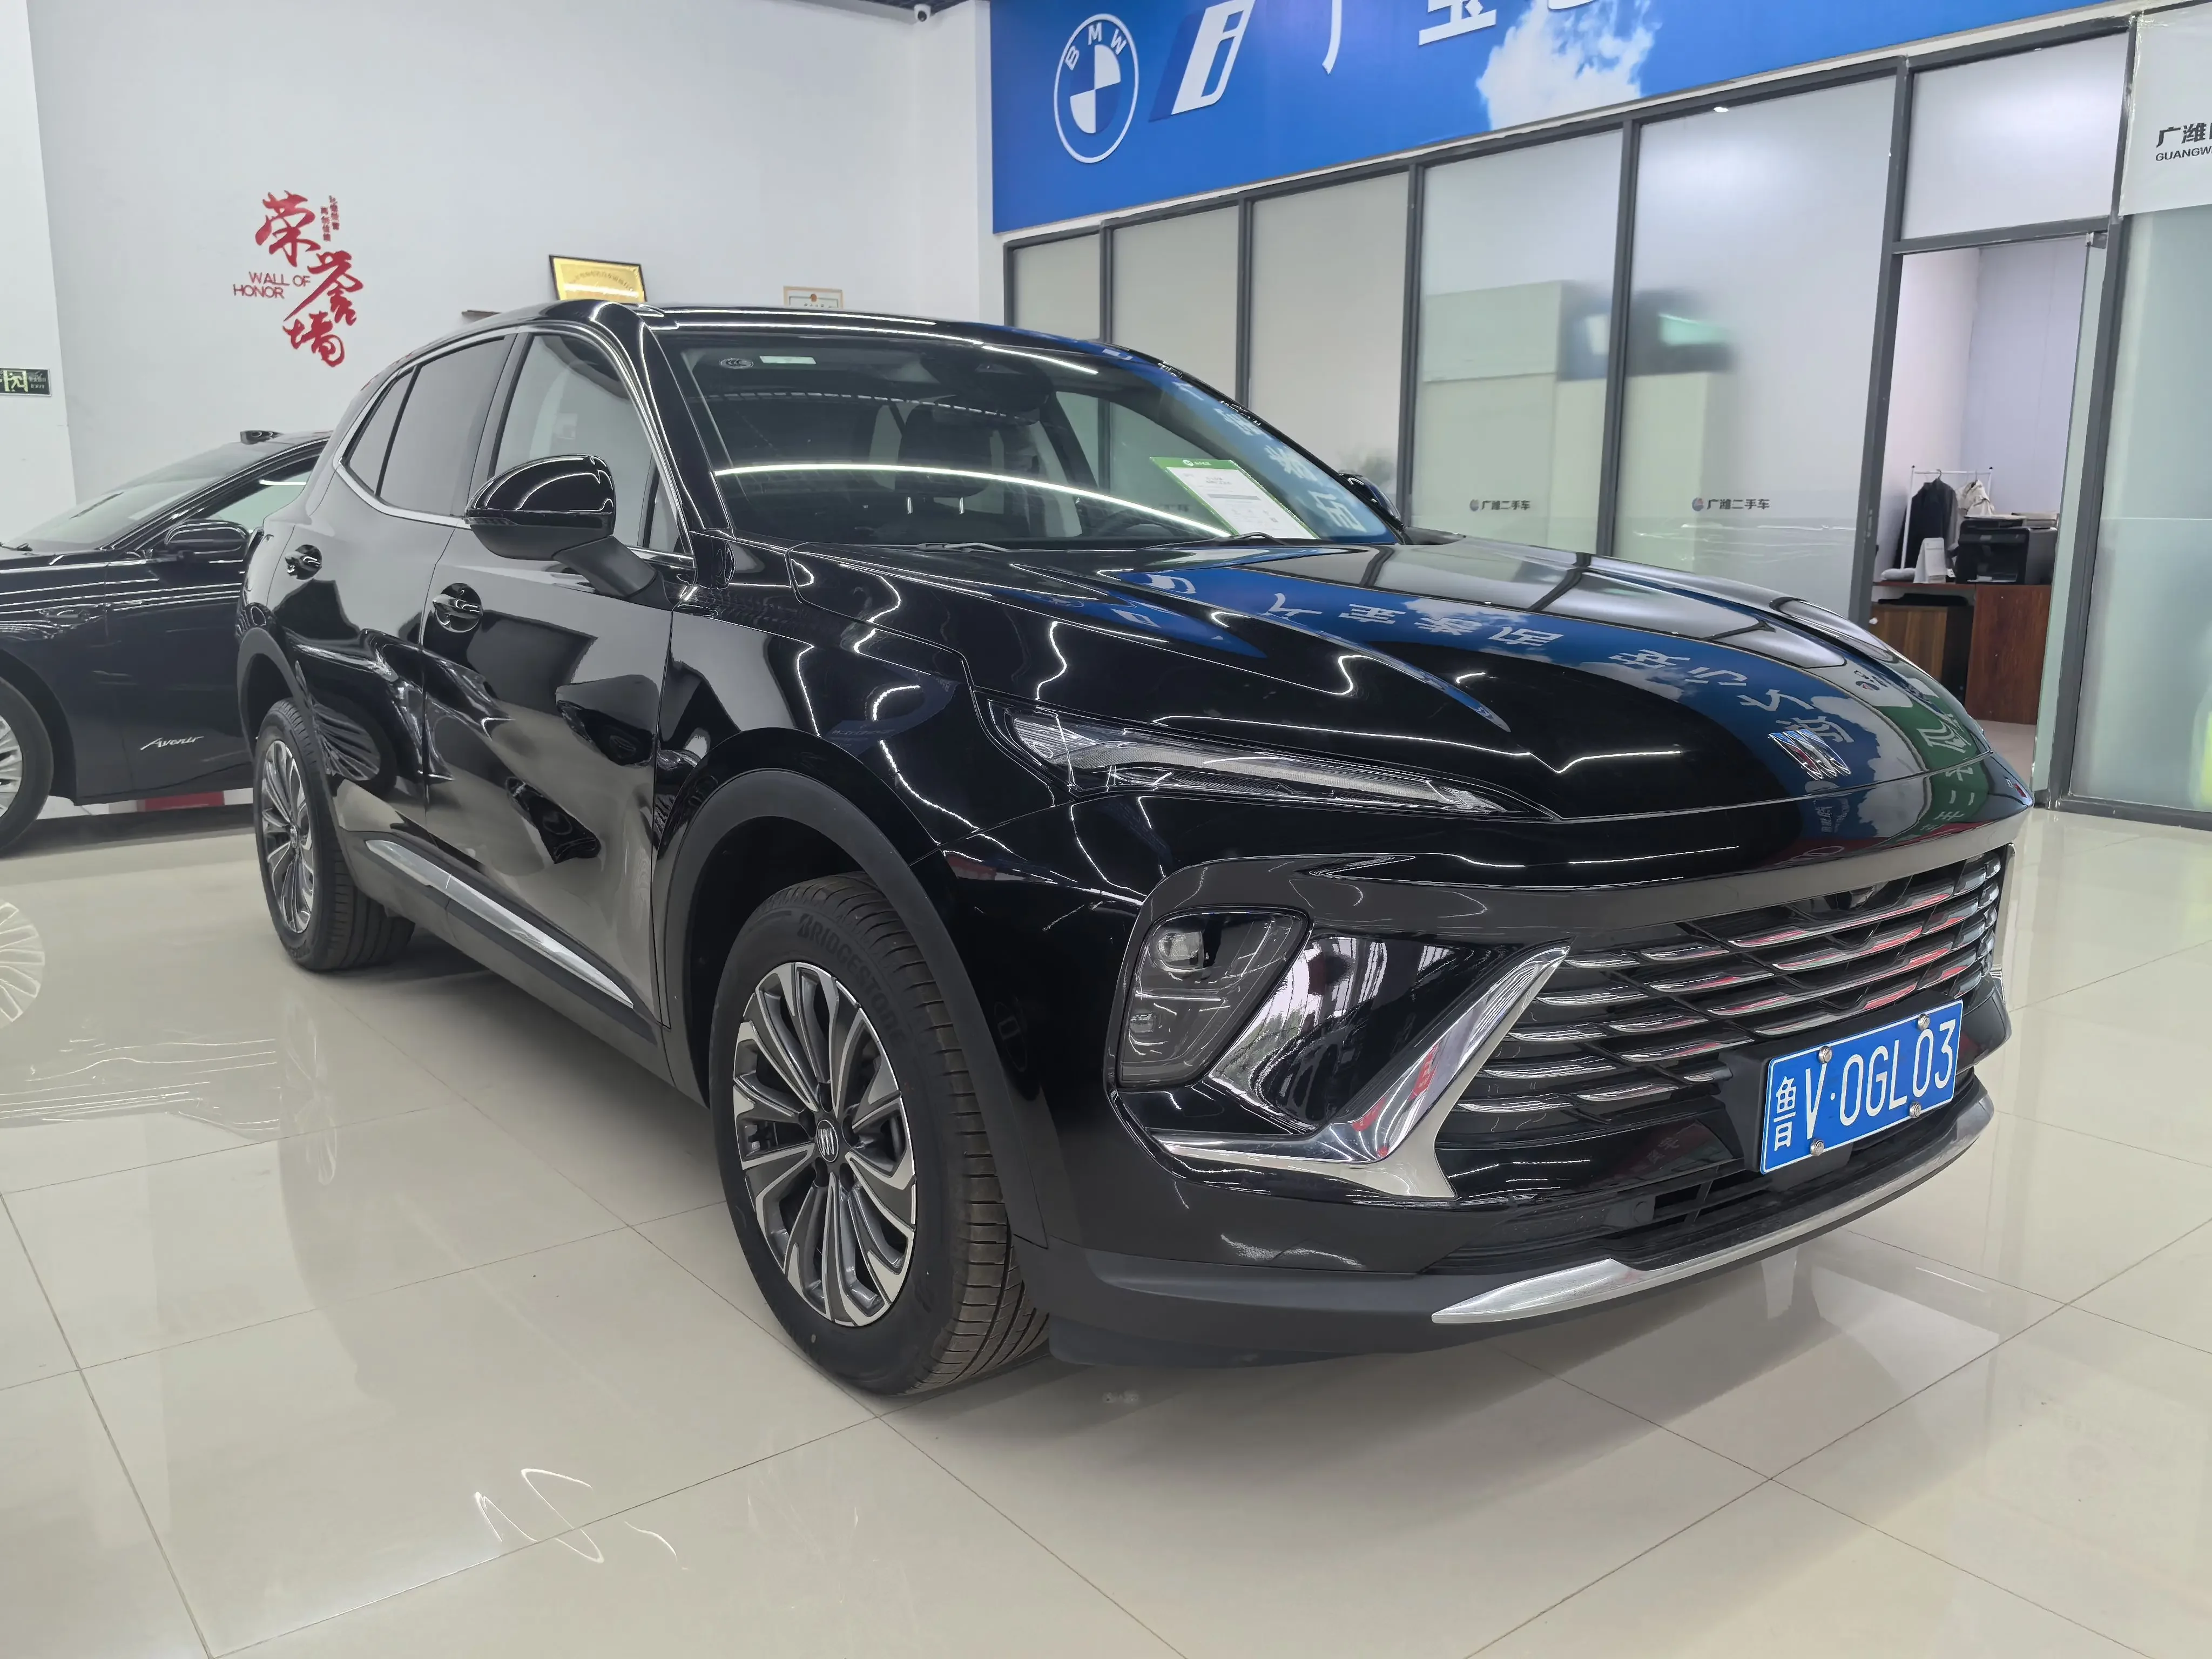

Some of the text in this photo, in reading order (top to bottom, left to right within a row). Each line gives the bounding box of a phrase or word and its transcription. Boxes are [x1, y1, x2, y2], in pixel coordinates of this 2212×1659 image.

[1065, 23, 1127, 71] BMW
[2156, 123, 2212, 148] 广潍
[2156, 146, 2212, 161] GUANGW
[248, 271, 311, 287] WALL OF
[255, 190, 364, 368] 荣誉墙
[233, 284, 285, 299] HONOR
[1707, 498, 1770, 510] 广潍二手车
[140, 736, 205, 751] Avenir
